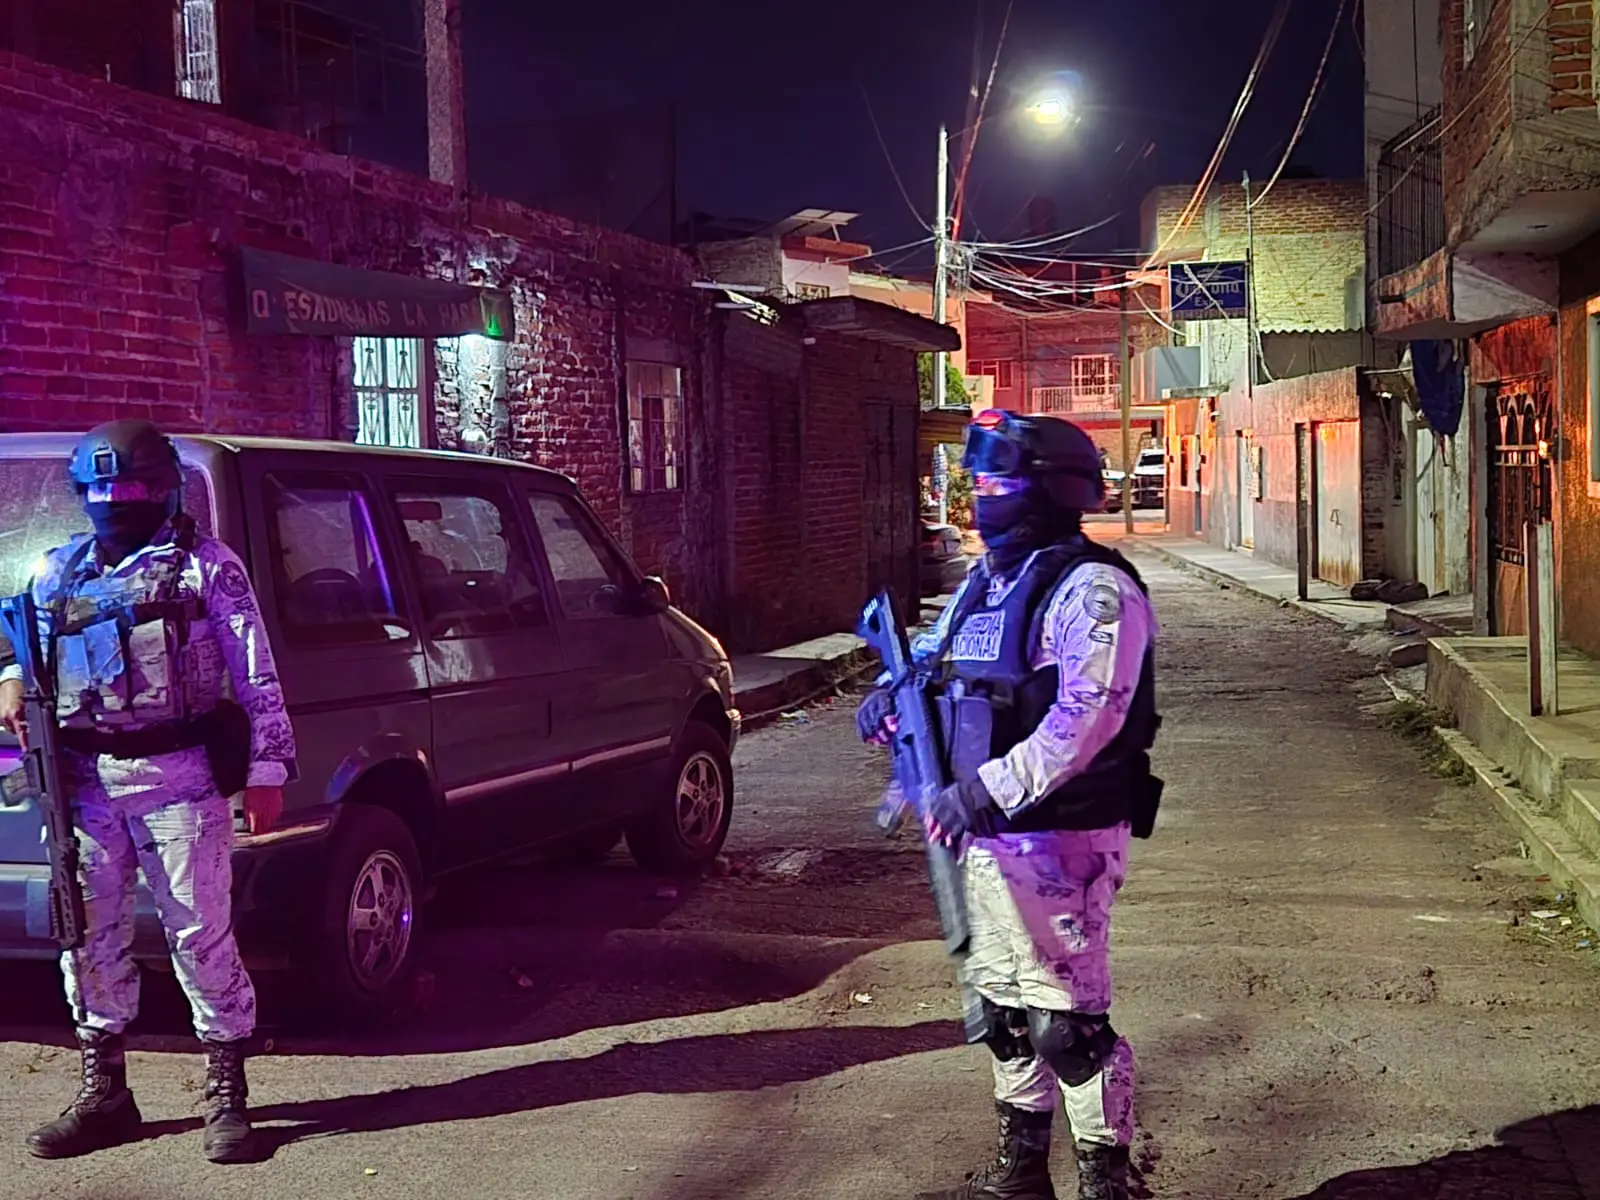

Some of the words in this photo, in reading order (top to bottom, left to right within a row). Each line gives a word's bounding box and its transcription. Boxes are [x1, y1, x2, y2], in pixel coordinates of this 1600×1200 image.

[1175, 282, 1240, 298] Coona
[252, 289, 392, 328] QESADILLAS
[401, 300, 428, 328] LA
